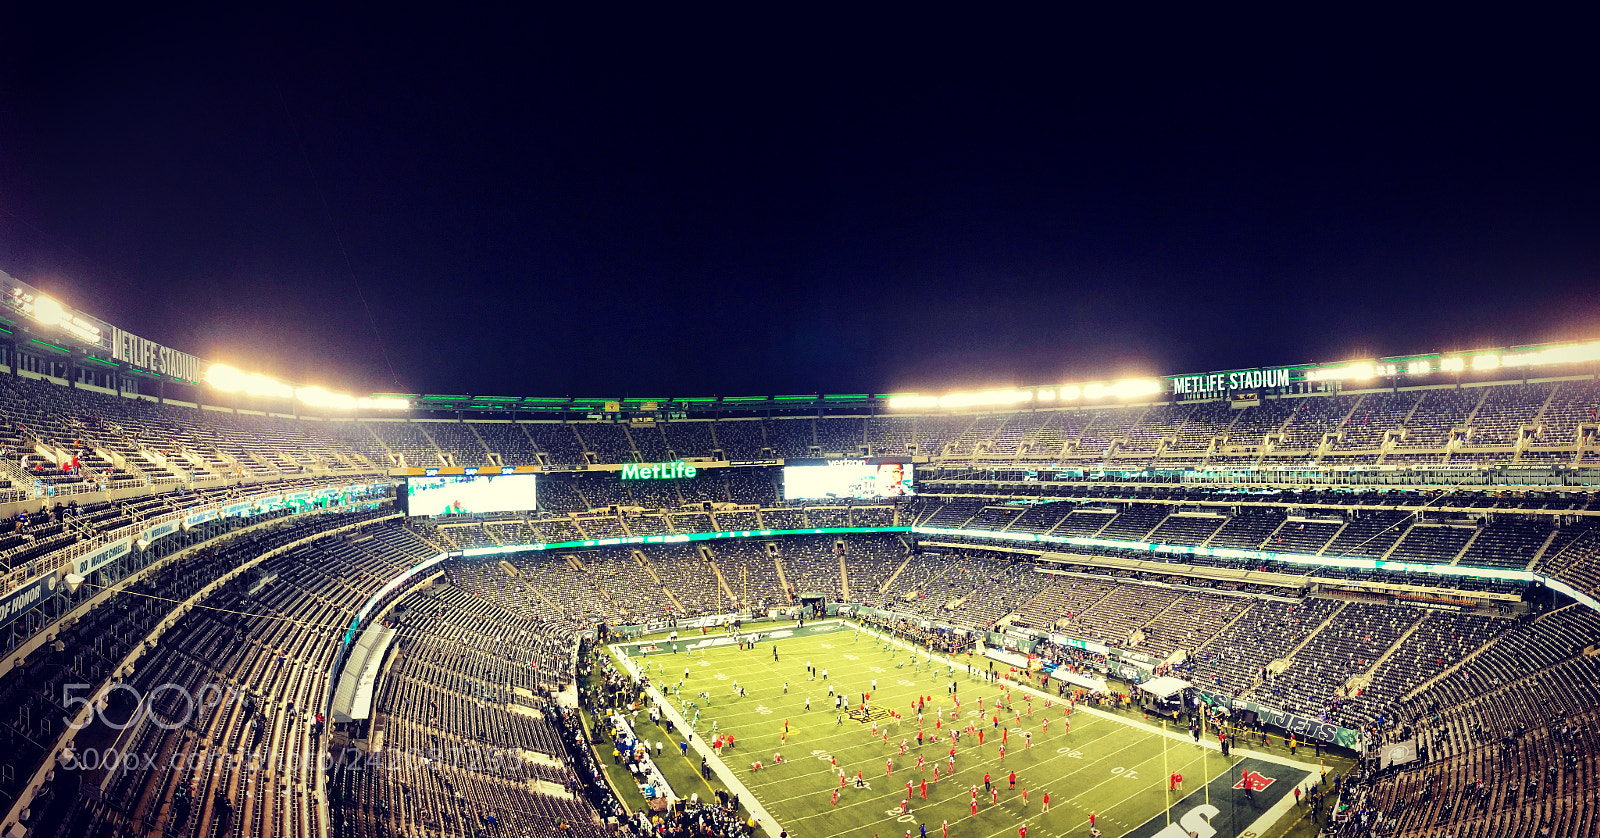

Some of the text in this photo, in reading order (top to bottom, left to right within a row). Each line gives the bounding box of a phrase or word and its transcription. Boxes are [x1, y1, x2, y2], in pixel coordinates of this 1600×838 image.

[113, 326, 200, 384] METLIFE STADIUM
[1174, 369, 1289, 395] METLIFE STADIUM
[621, 461, 697, 479] MetLife
[828, 458, 866, 466] verizon
[80, 560, 88, 573] 80
[11, 585, 40, 614] HONOR
[1274, 711, 1337, 742] JETS
